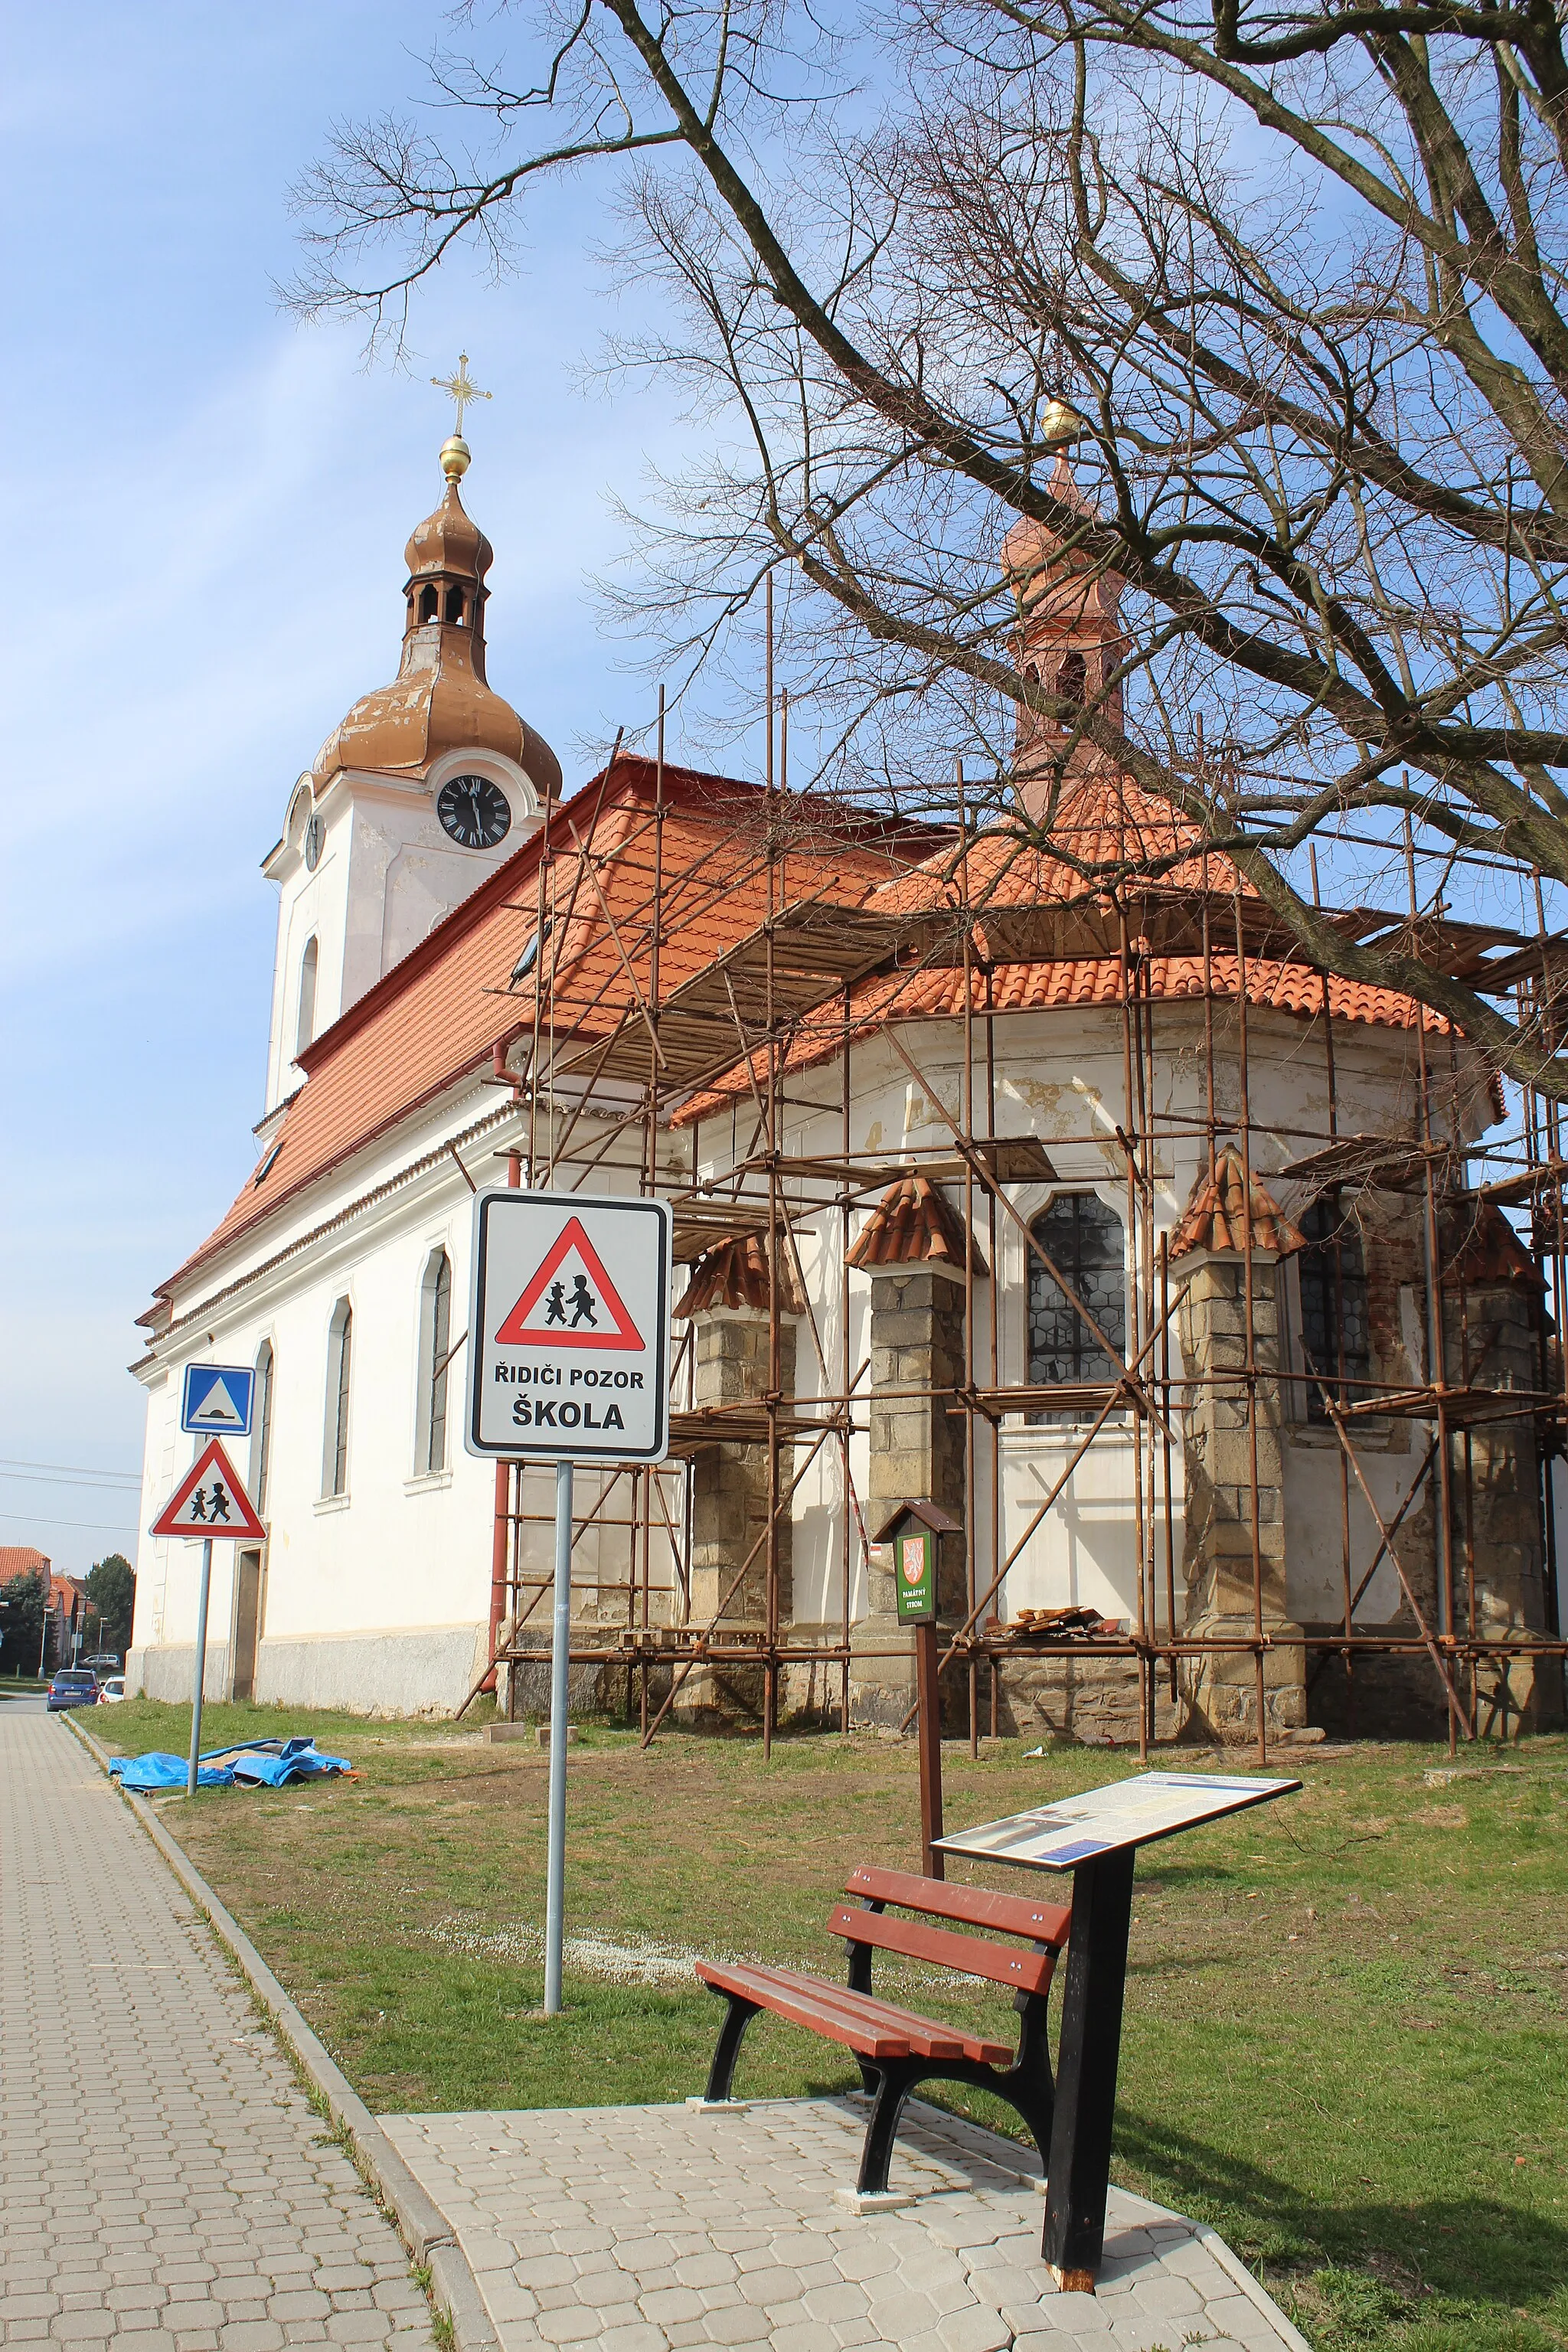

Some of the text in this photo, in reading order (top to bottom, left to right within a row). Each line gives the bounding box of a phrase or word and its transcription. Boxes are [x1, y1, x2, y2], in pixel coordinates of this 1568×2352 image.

[495, 1361, 645, 1390] ŘIDIČI POZOR
[511, 1393, 625, 1430] ŠKOLA
[902, 1587, 926, 1599] PAMÁTNÝ
[906, 1599, 923, 1609] STROM
